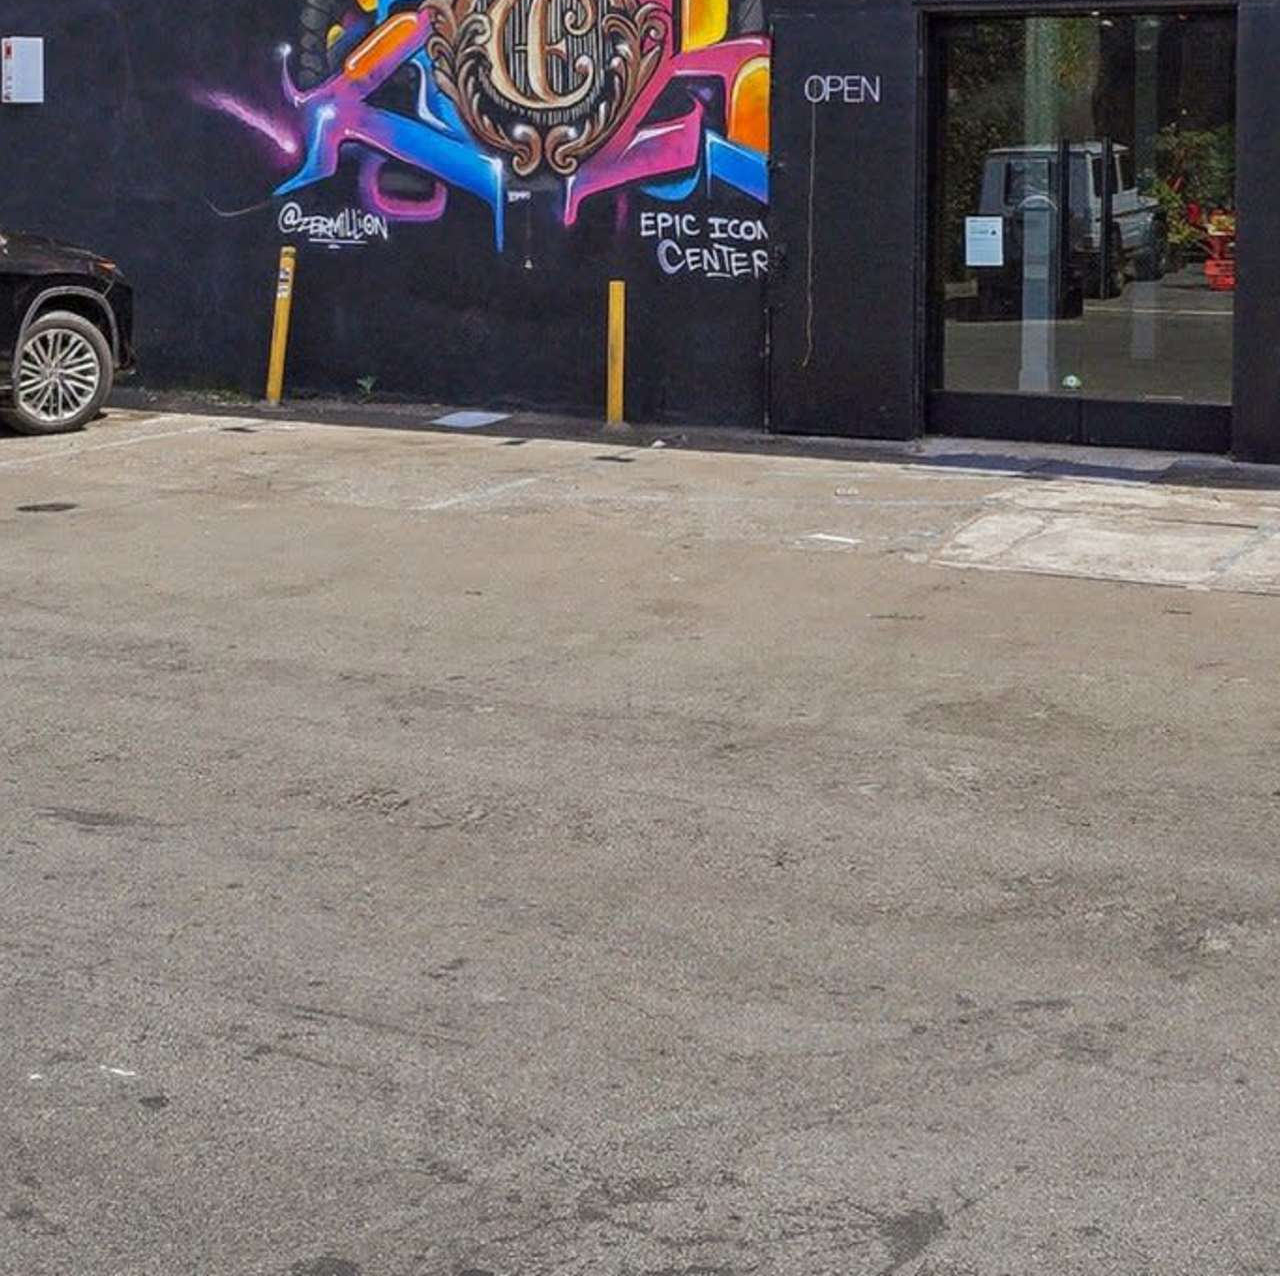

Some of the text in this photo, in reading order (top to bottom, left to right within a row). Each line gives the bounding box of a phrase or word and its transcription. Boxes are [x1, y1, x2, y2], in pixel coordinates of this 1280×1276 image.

[804, 74, 881, 103] OPEN
[640, 212, 700, 239] EPIC
[656, 238, 768, 279] CENTER
